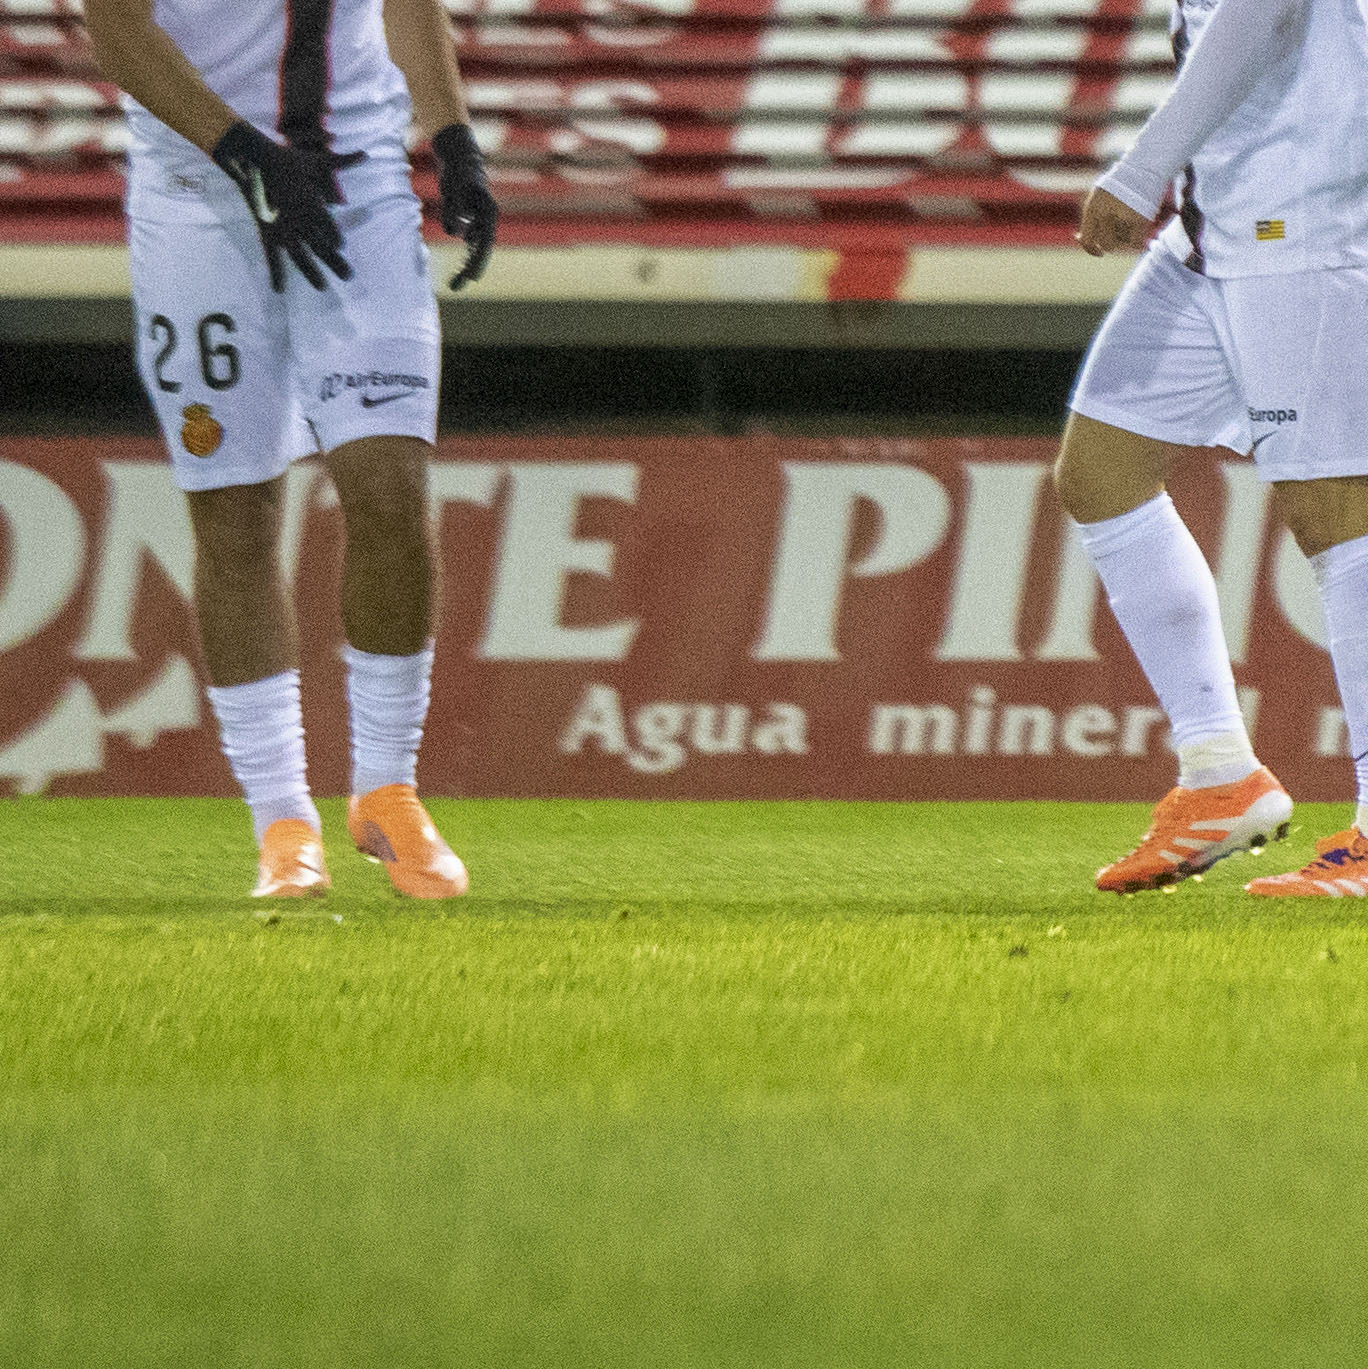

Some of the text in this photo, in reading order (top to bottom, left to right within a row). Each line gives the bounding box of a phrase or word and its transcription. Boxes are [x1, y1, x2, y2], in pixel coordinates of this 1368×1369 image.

[149, 313, 242, 394] 26
[560, 685, 808, 774] Agua
[868, 682, 1261, 759] minerl
